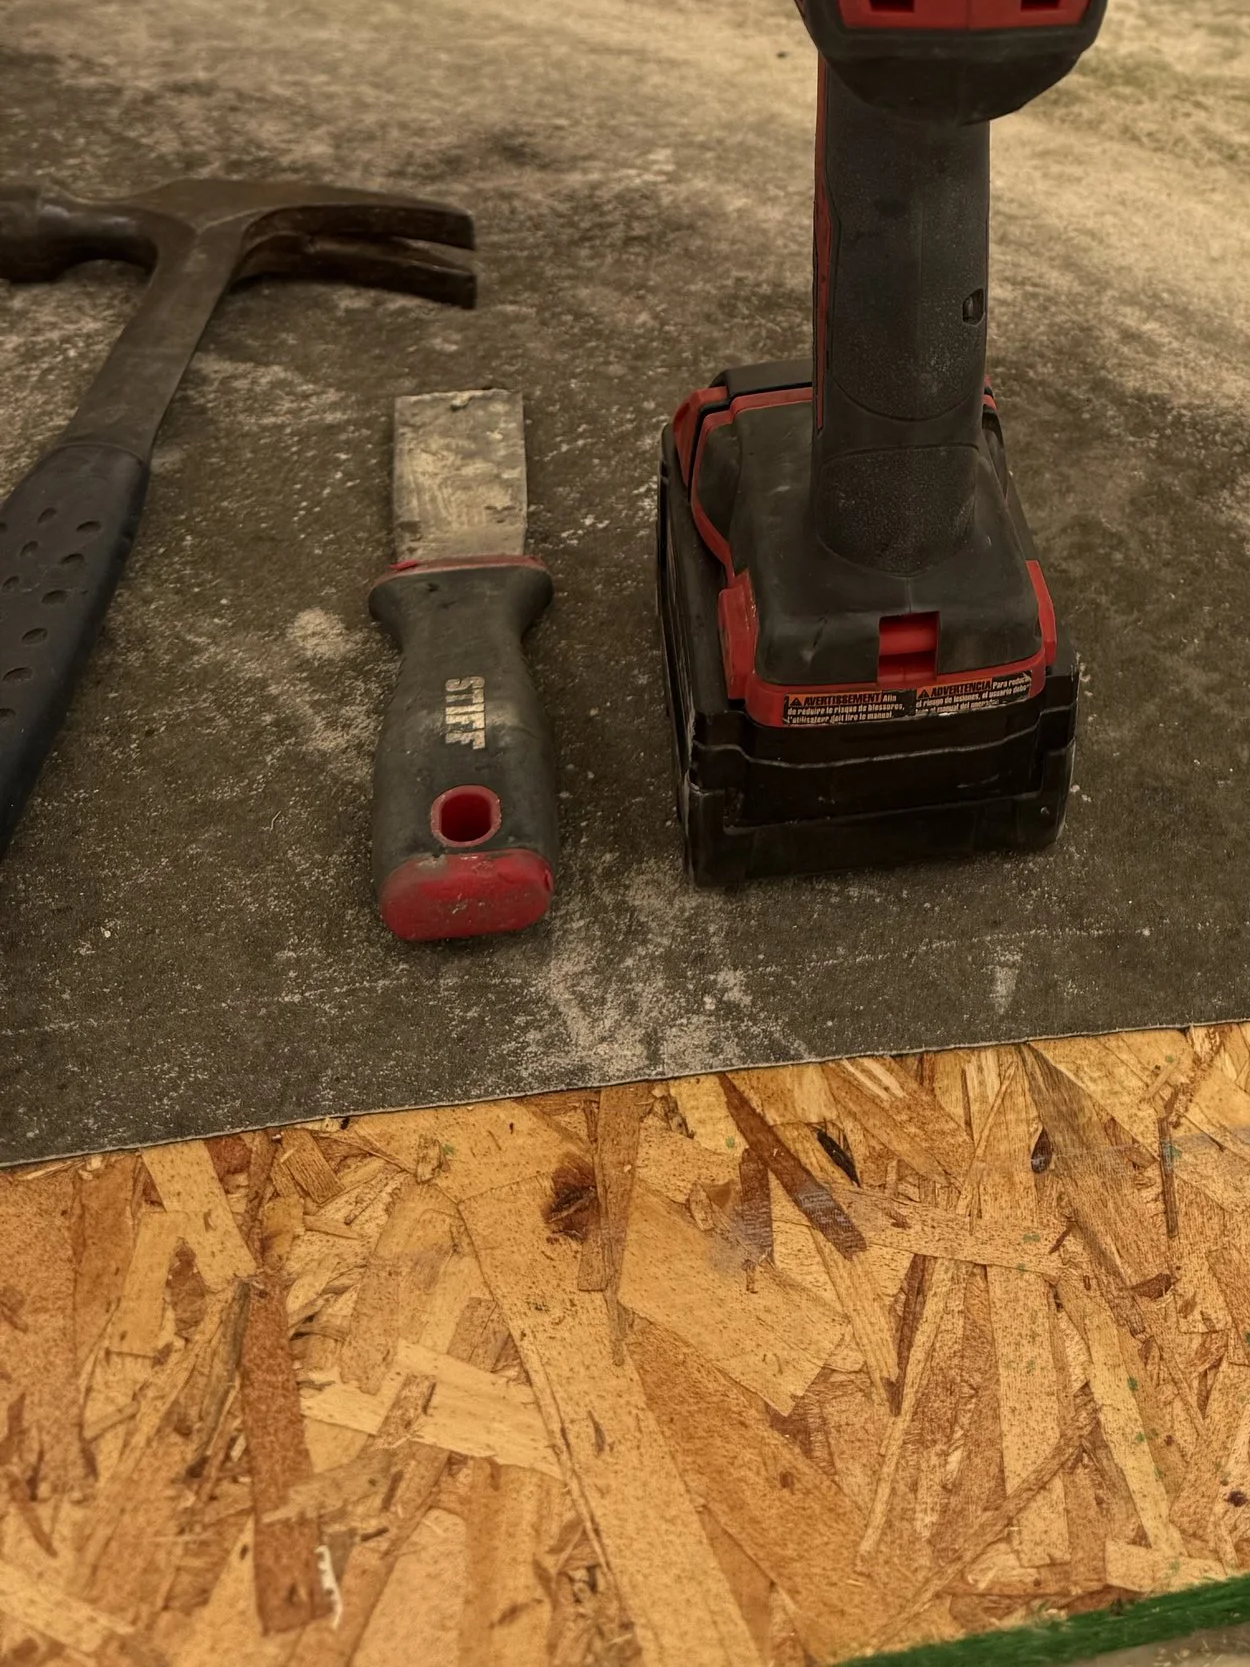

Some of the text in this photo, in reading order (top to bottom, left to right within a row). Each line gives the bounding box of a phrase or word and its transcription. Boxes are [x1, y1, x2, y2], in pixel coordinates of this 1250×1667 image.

[931, 680, 991, 697] ADVERTENCIA
[993, 680, 1008, 690] Para
[804, 693, 881, 706] AVERTISSEMENT
[446, 676, 486, 750] STIFF
